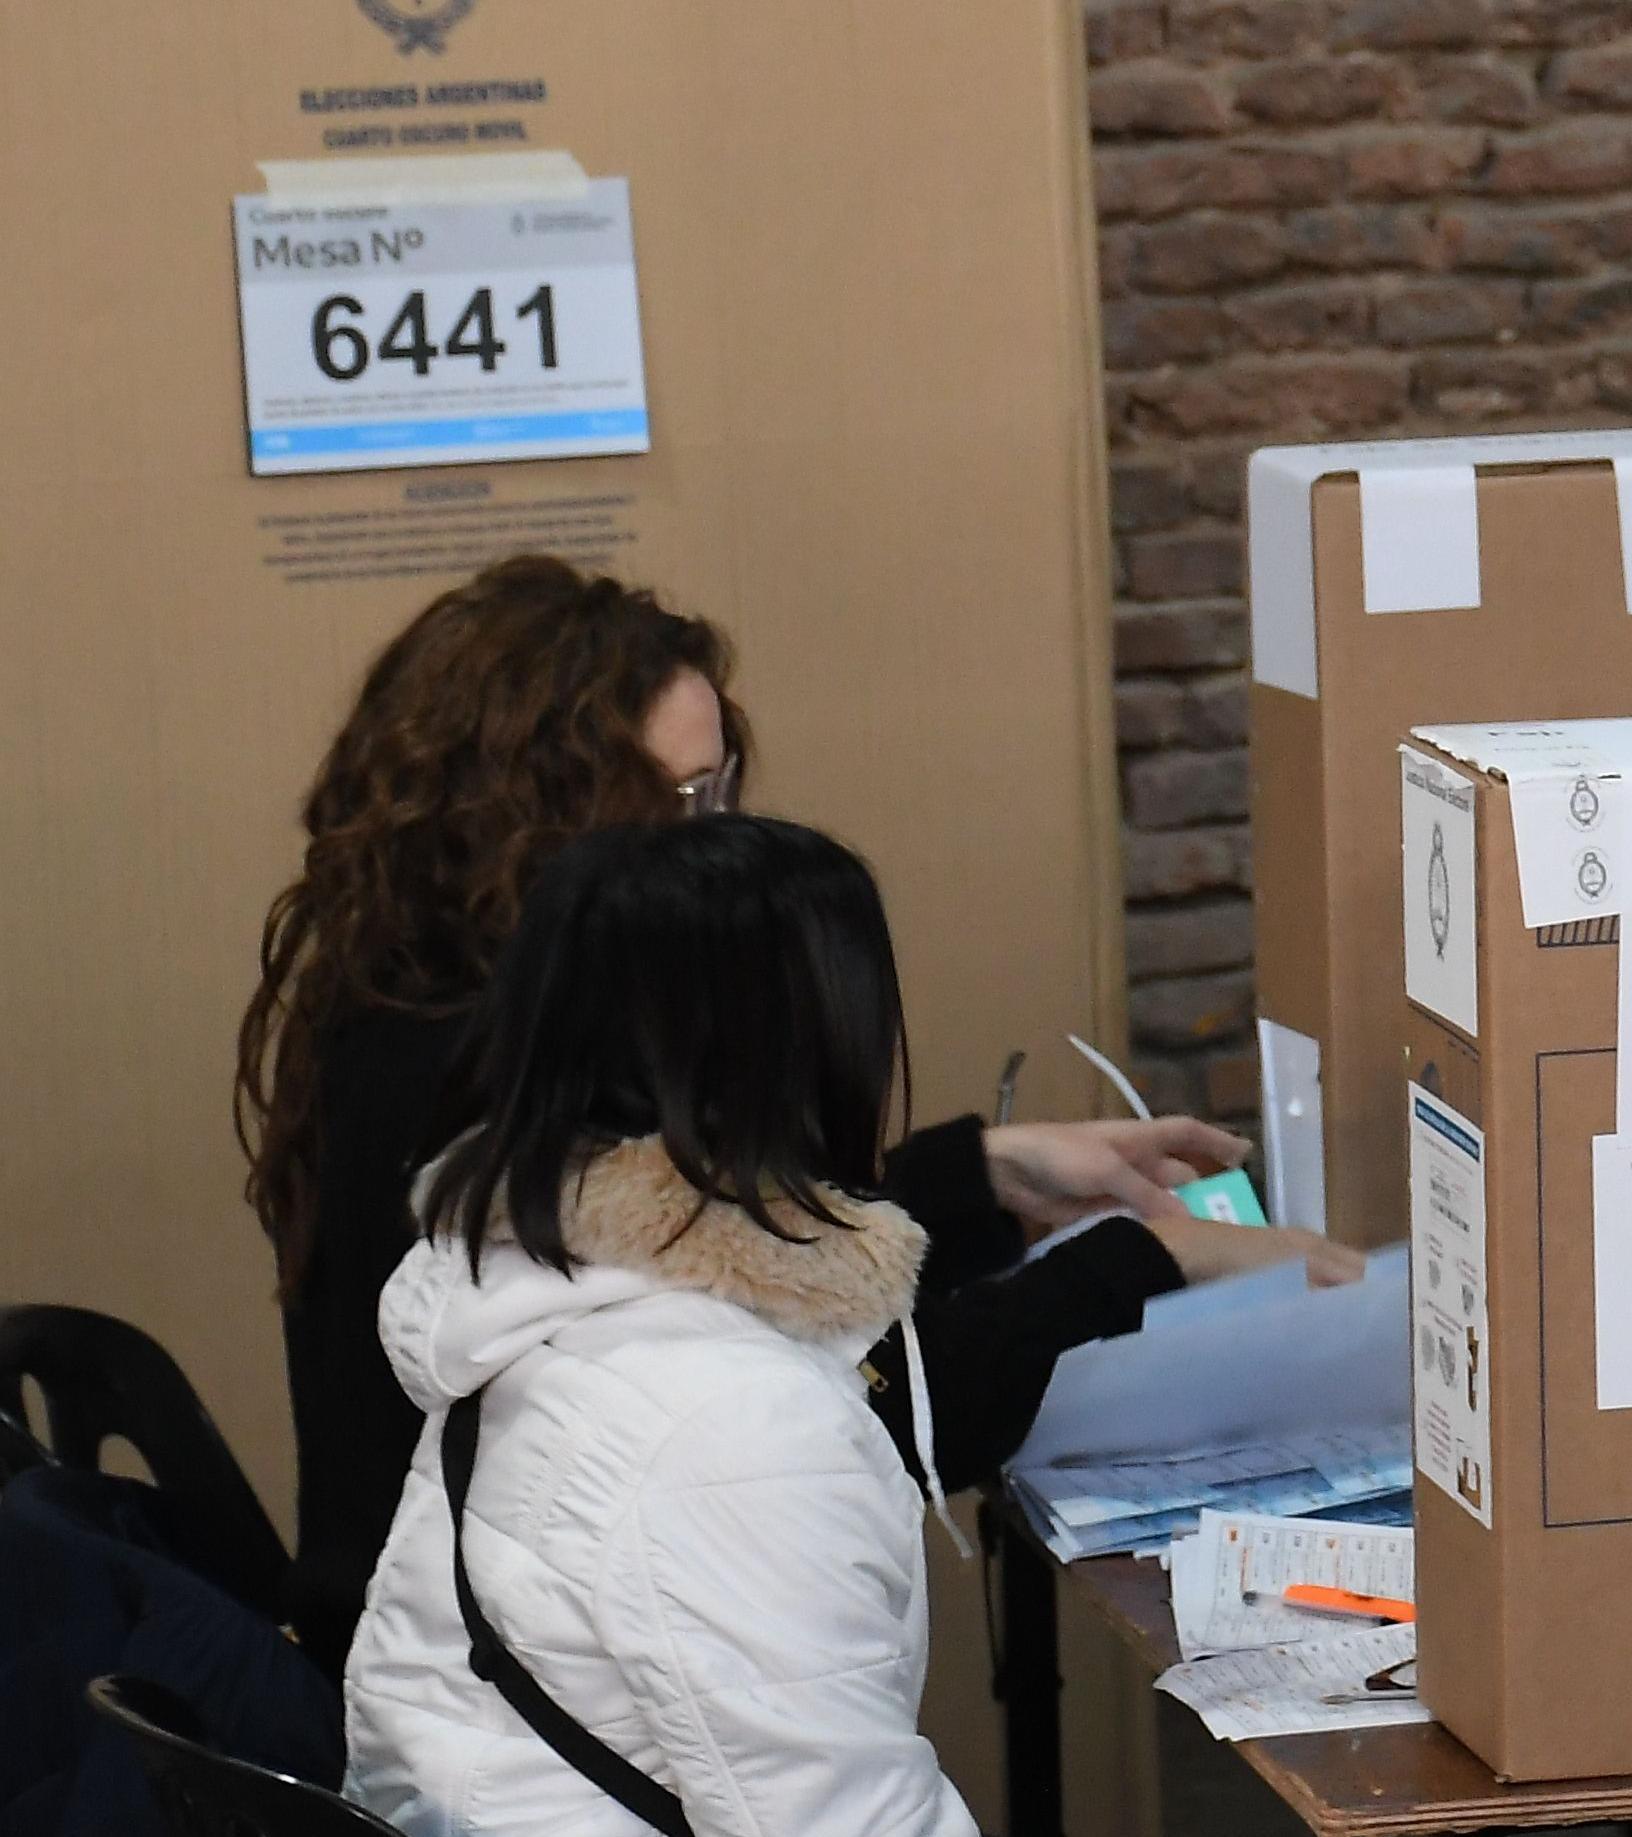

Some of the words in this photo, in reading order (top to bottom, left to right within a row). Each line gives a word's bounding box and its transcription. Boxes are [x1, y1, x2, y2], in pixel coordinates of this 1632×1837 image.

[300, 88, 418, 113] ELECCIONES
[426, 79, 545, 104] ARGENTINAS
[254, 234, 360, 270] Mesa
[312, 284, 557, 381] 6441
